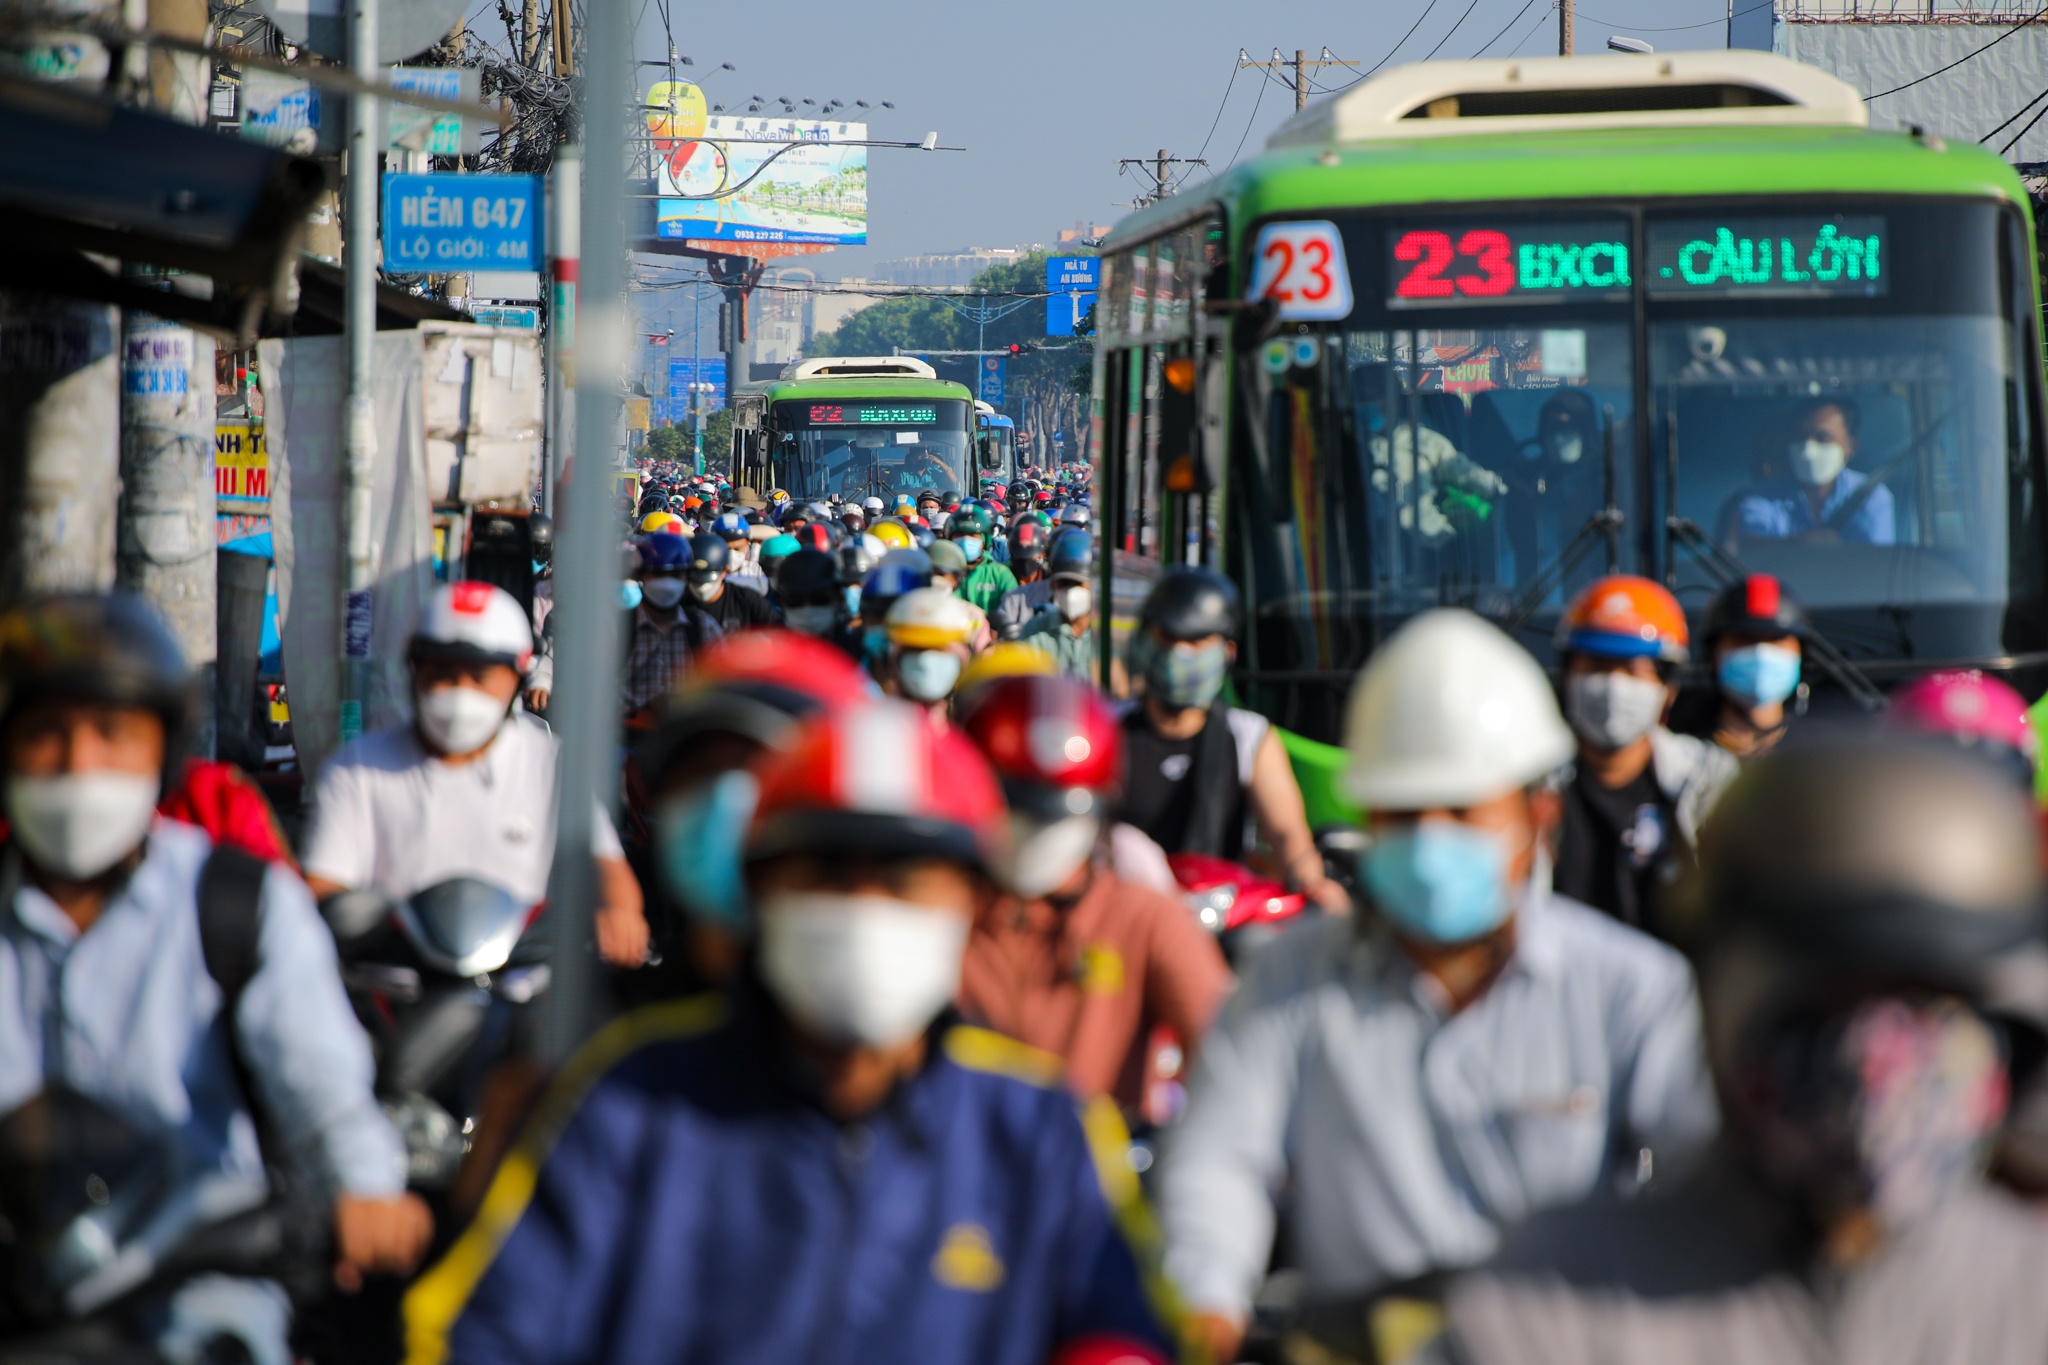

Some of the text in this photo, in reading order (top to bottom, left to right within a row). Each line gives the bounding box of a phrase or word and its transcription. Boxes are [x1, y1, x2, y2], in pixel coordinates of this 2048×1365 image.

[401, 185, 527, 229] HẺM 647
[400, 234, 431, 260] LỘ
[497, 241, 528, 259] 4M
[735, 230, 754, 239] 0938
[1064, 259, 1089, 271] NGÃ TƯ
[1264, 239, 1332, 302] 23
[1394, 230, 1515, 298] 23
[1060, 274, 1070, 284] AN
